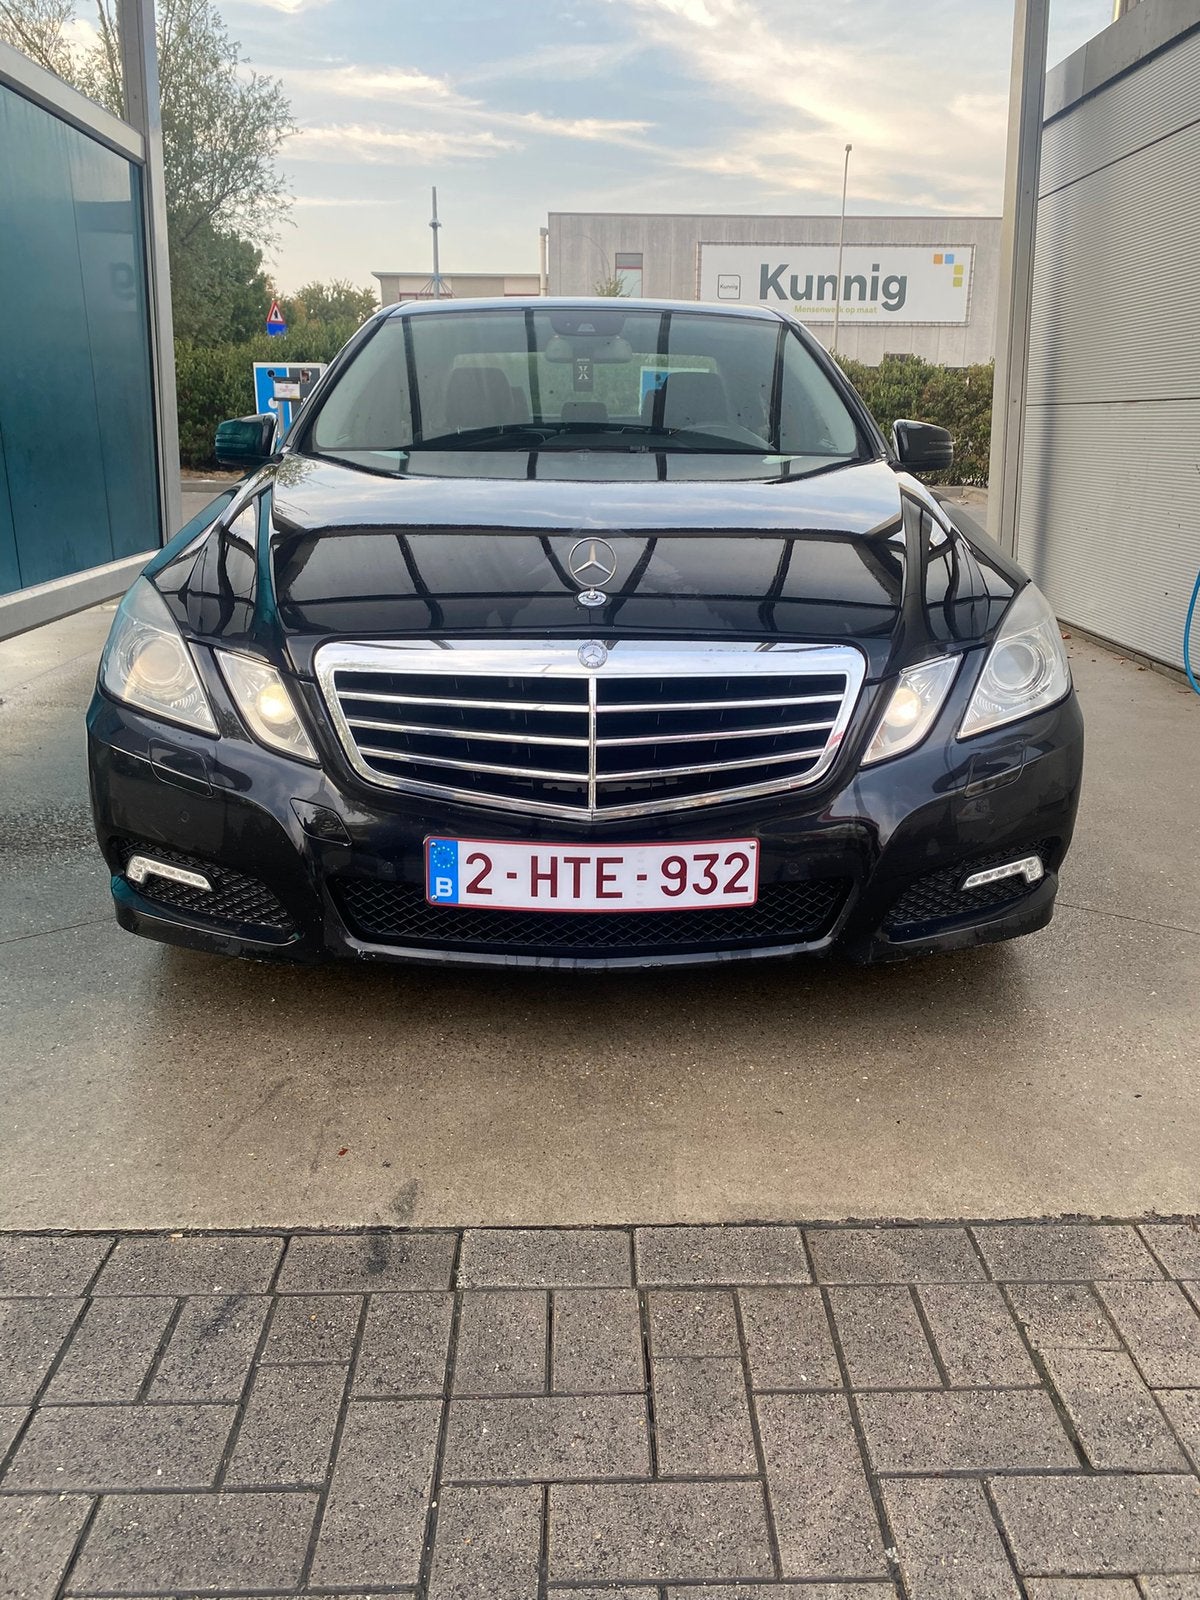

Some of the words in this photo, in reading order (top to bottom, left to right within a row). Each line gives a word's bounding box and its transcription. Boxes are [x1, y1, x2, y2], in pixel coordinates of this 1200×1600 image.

[760, 264, 908, 312] Kunnig
[846, 306, 855, 314] op
[435, 877, 453, 897] B
